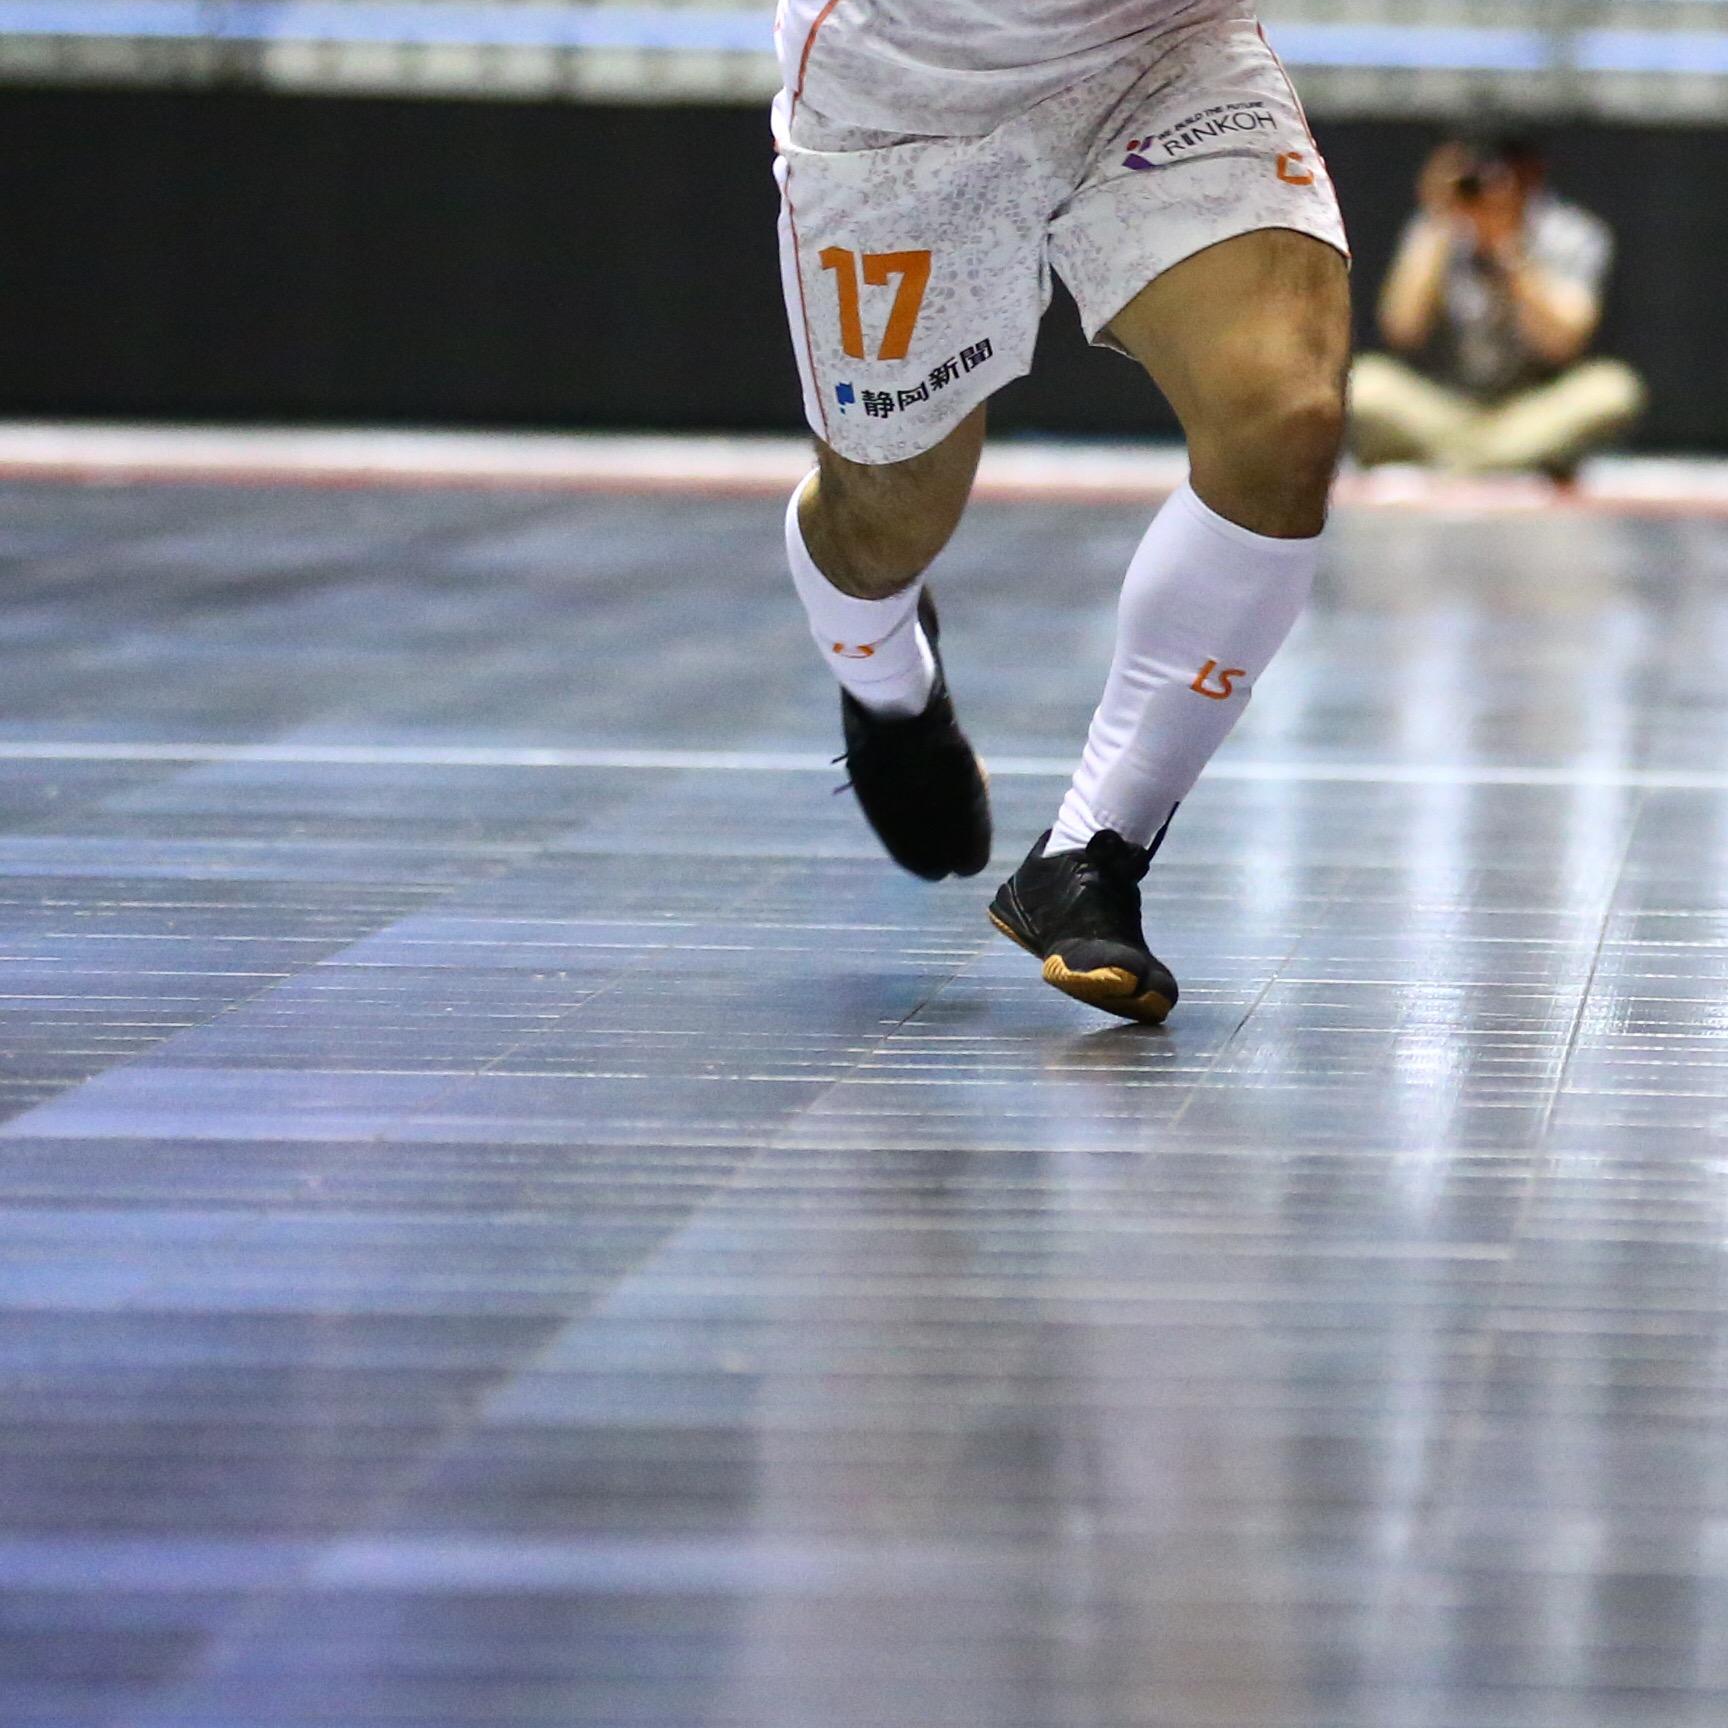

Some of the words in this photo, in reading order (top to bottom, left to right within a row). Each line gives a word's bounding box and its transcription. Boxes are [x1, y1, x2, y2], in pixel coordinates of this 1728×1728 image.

[1162, 110, 1278, 157] RINKOH
[818, 246, 933, 361] 17
[861, 337, 993, 419] 静岡新聞
